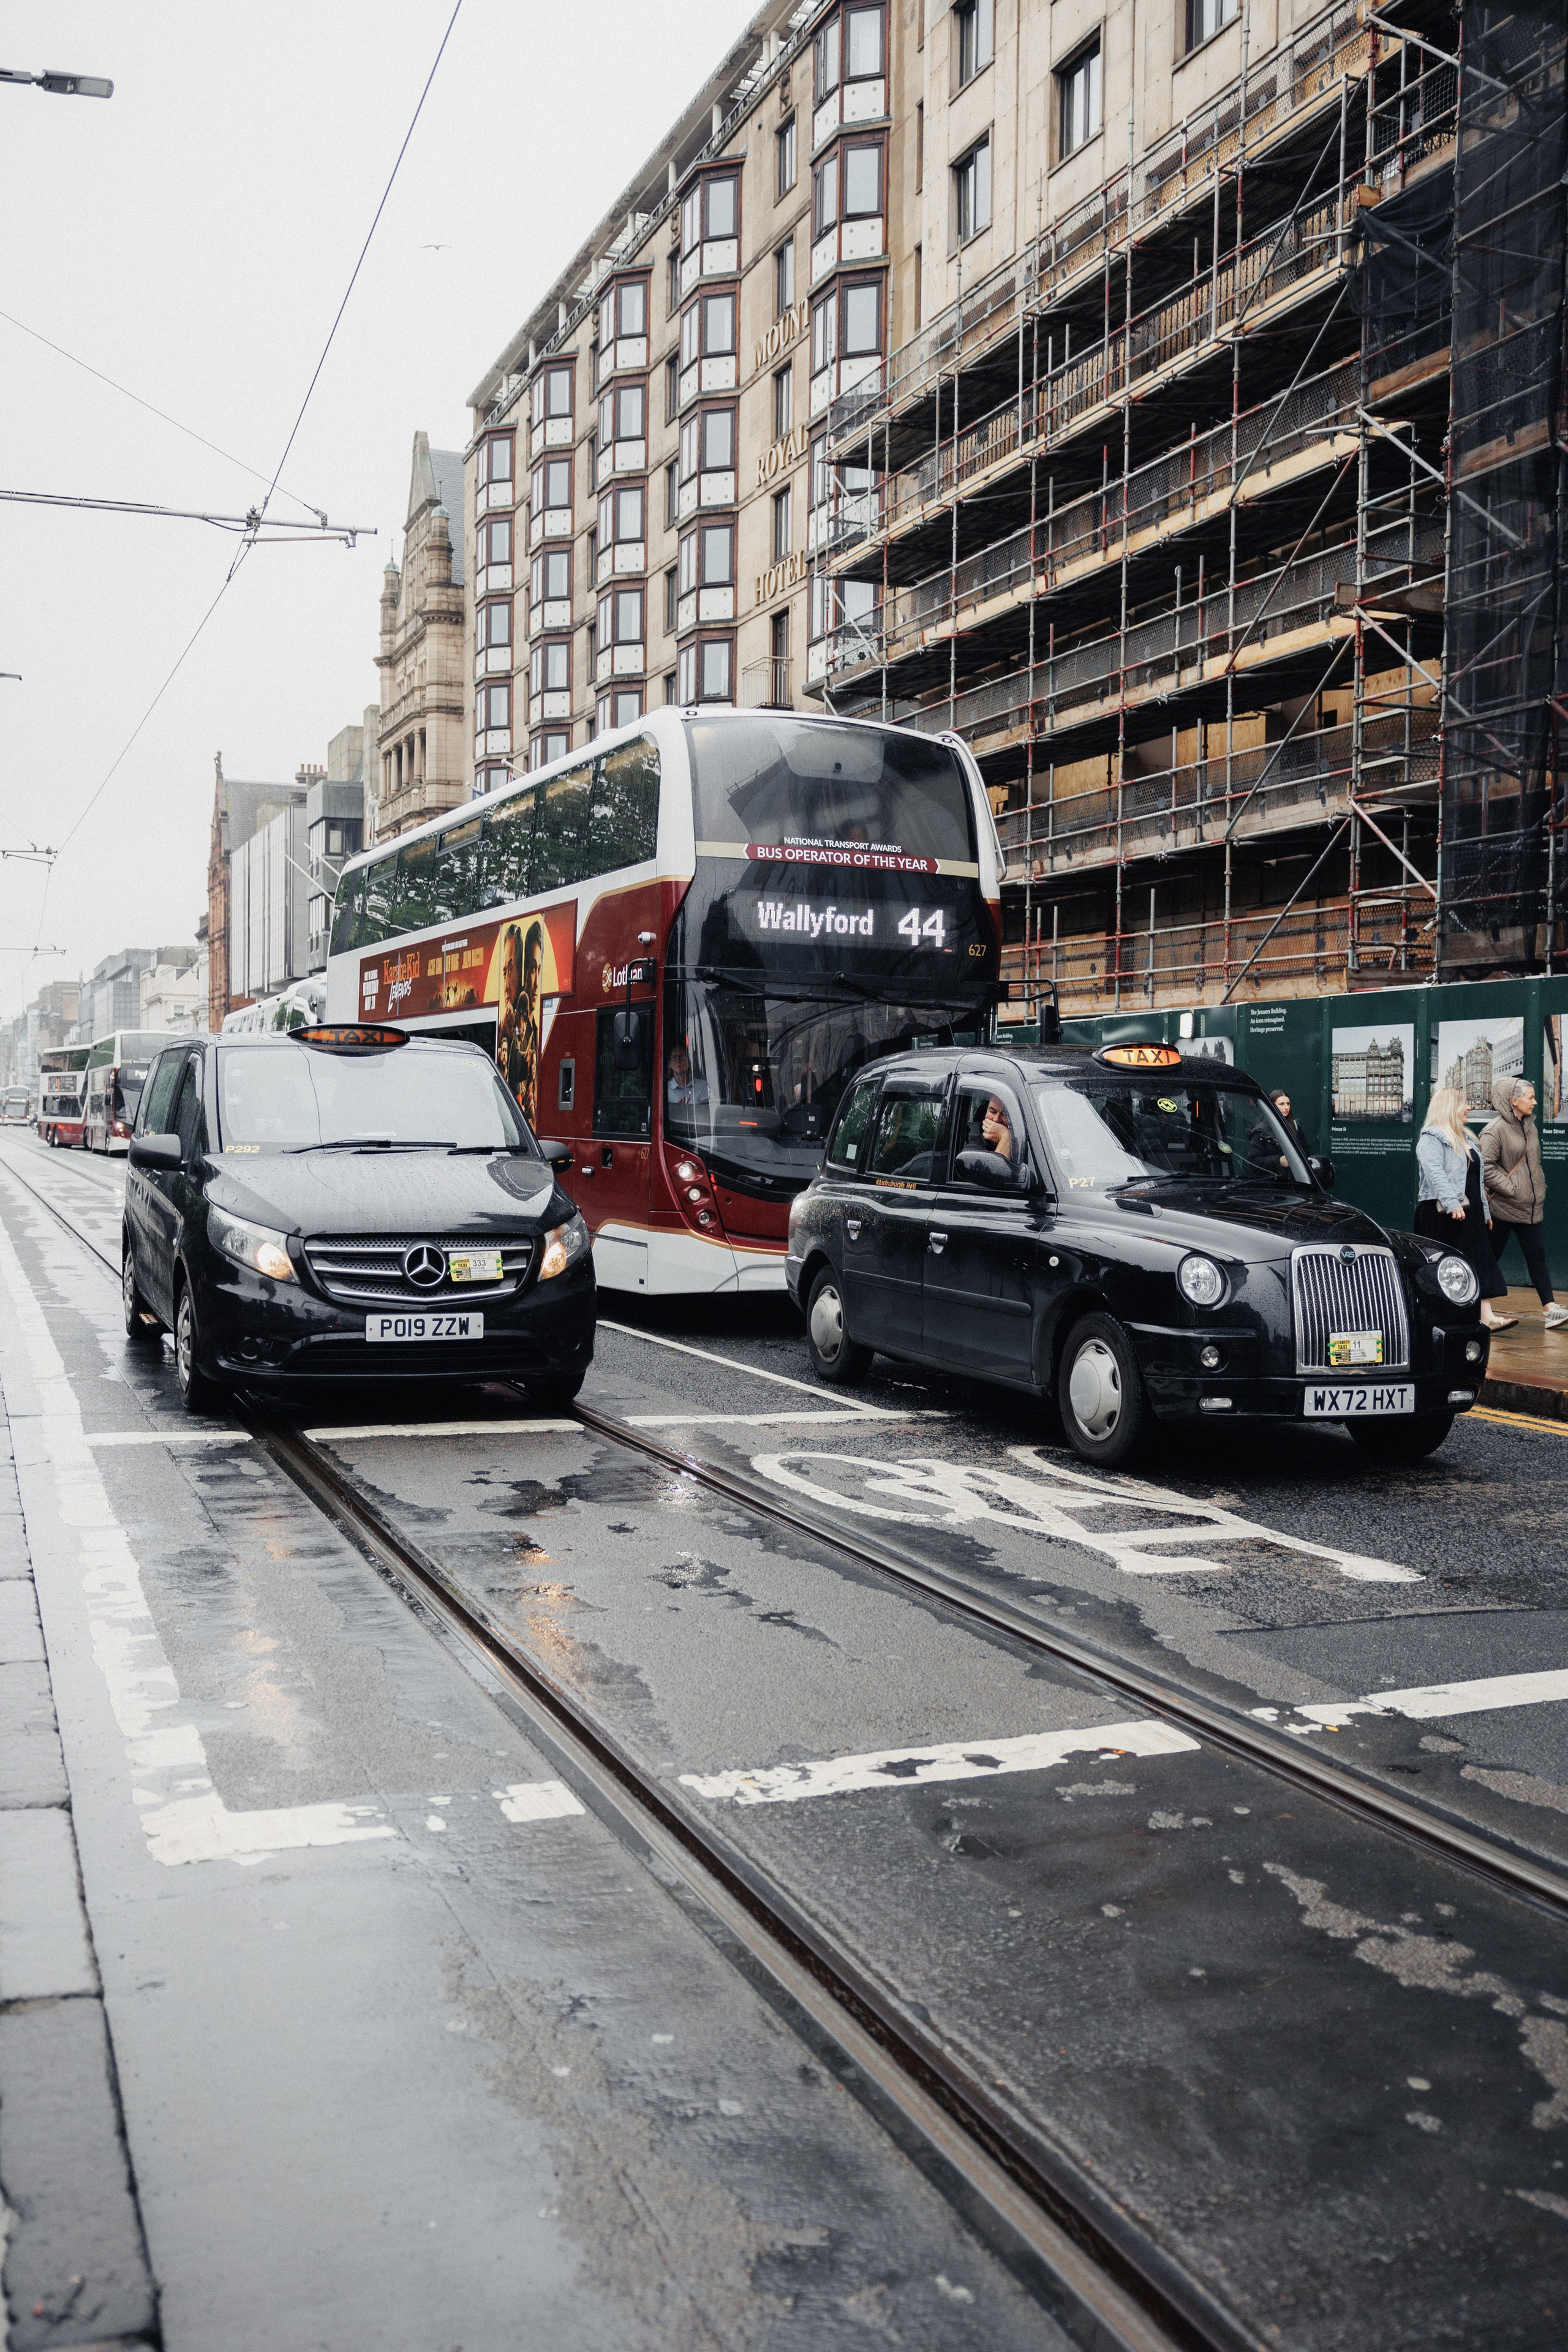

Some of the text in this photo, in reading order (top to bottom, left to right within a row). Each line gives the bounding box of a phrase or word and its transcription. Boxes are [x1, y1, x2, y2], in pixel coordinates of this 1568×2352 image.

[755, 297, 809, 371] MOUNT
[756, 423, 808, 487] ROYAL
[755, 550, 808, 606] HOTEL
[784, 837, 902, 853] NATIONAL TRANSPORT AWARDS
[757, 846, 928, 870] BUS OPERATOR OF THE YEAR
[758, 902, 945, 947] Wallyford 44
[969, 944, 986, 957] 627
[383, 960, 407, 985] Karate
[407, 951, 420, 979] Kid
[330, 1030, 385, 1043] TAXI
[1123, 1050, 1170, 1063] TAXI
[641, 1147, 649, 1159] 627
[1068, 1177, 1096, 1188] P27
[380, 1317, 469, 1337] PO19 ZZW
[1314, 1388, 1407, 1411] WX72 HXT
